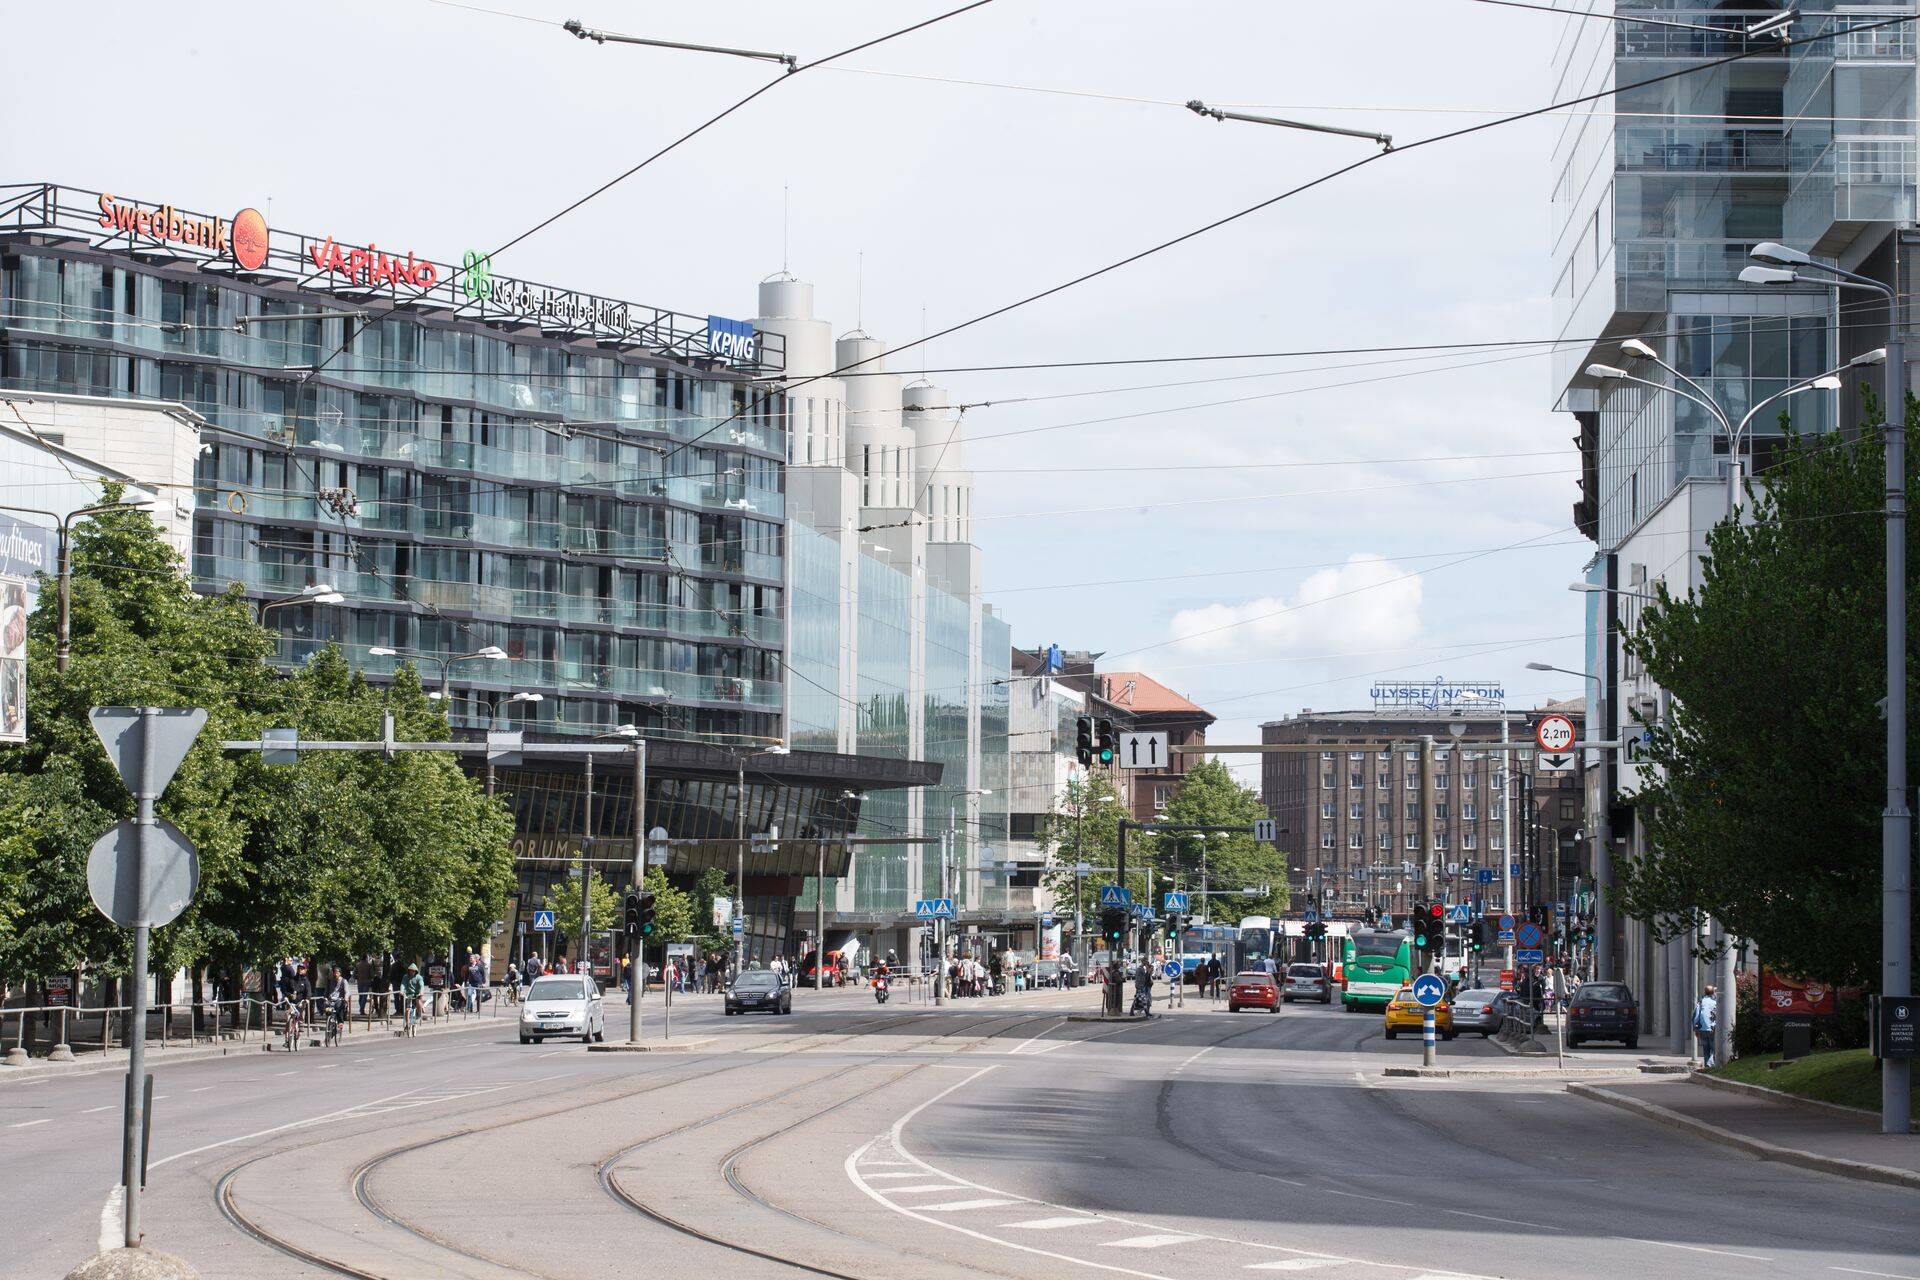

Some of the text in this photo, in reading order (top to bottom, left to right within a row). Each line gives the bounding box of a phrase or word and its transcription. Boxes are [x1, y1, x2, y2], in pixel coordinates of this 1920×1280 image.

[98, 192, 229, 253] Swedbank
[308, 235, 437, 289] VAPIANO
[493, 284, 541, 313] Nordic
[711, 330, 755, 360] KPMG
[1370, 688, 1431, 699] ULYSSE
[507, 838, 568, 859] ORUM
